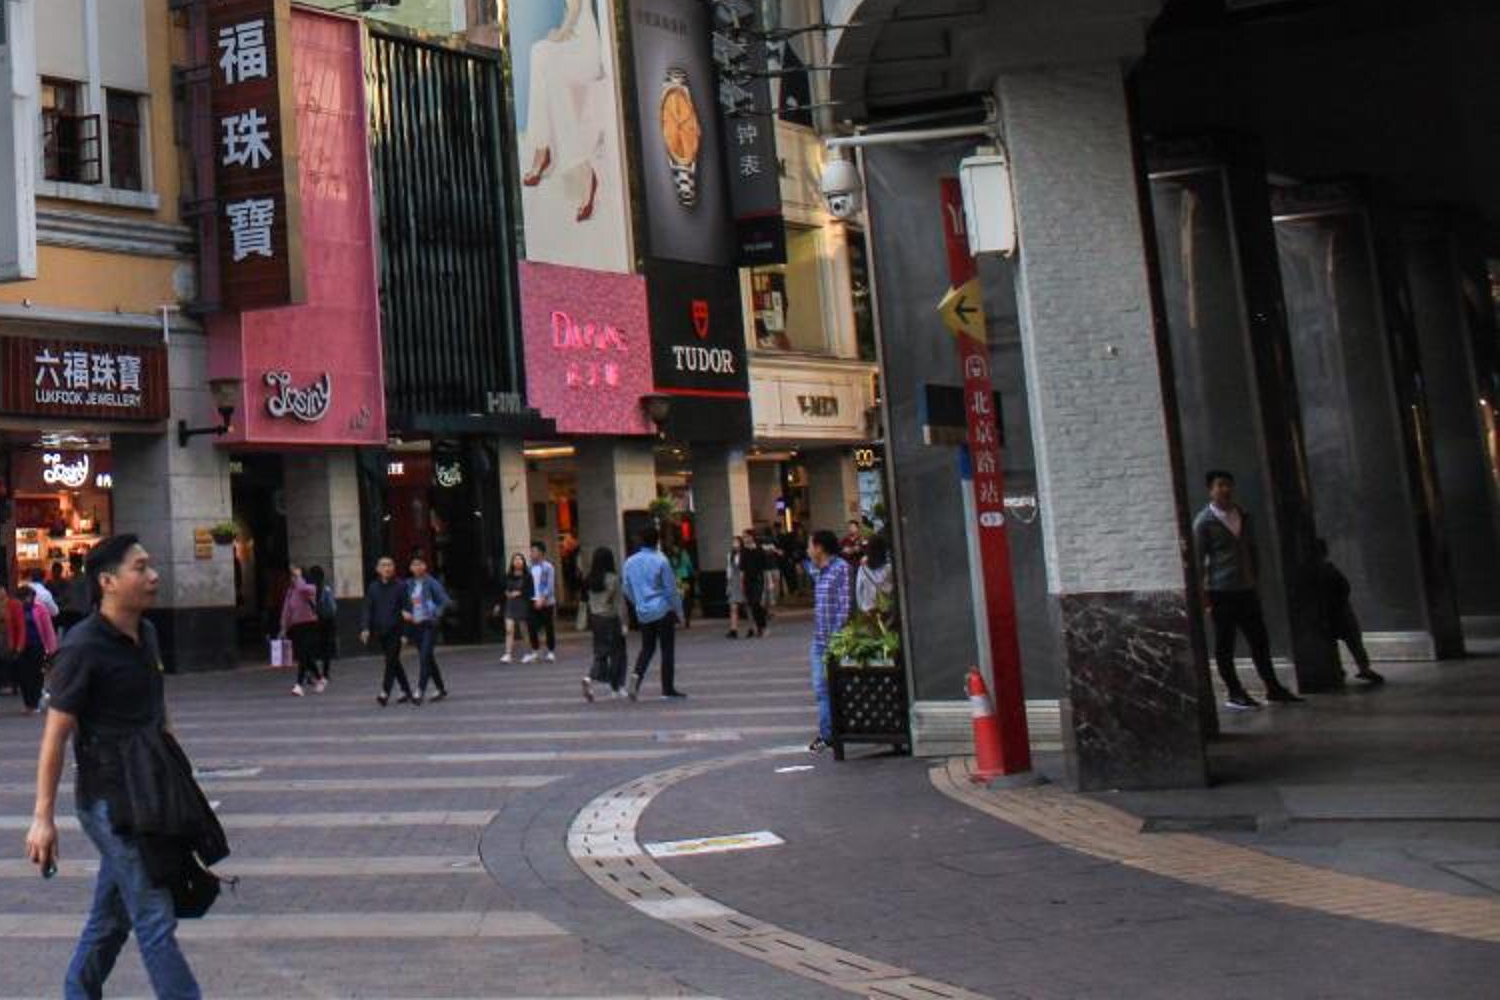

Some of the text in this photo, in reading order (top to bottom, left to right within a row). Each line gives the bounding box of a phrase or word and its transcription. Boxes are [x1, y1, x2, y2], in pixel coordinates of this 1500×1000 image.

[35, 349, 141, 391] 六福珠寶
[672, 345, 735, 374] TUDOR
[36, 389, 142, 407] LUKFOOK JEWELLERY
